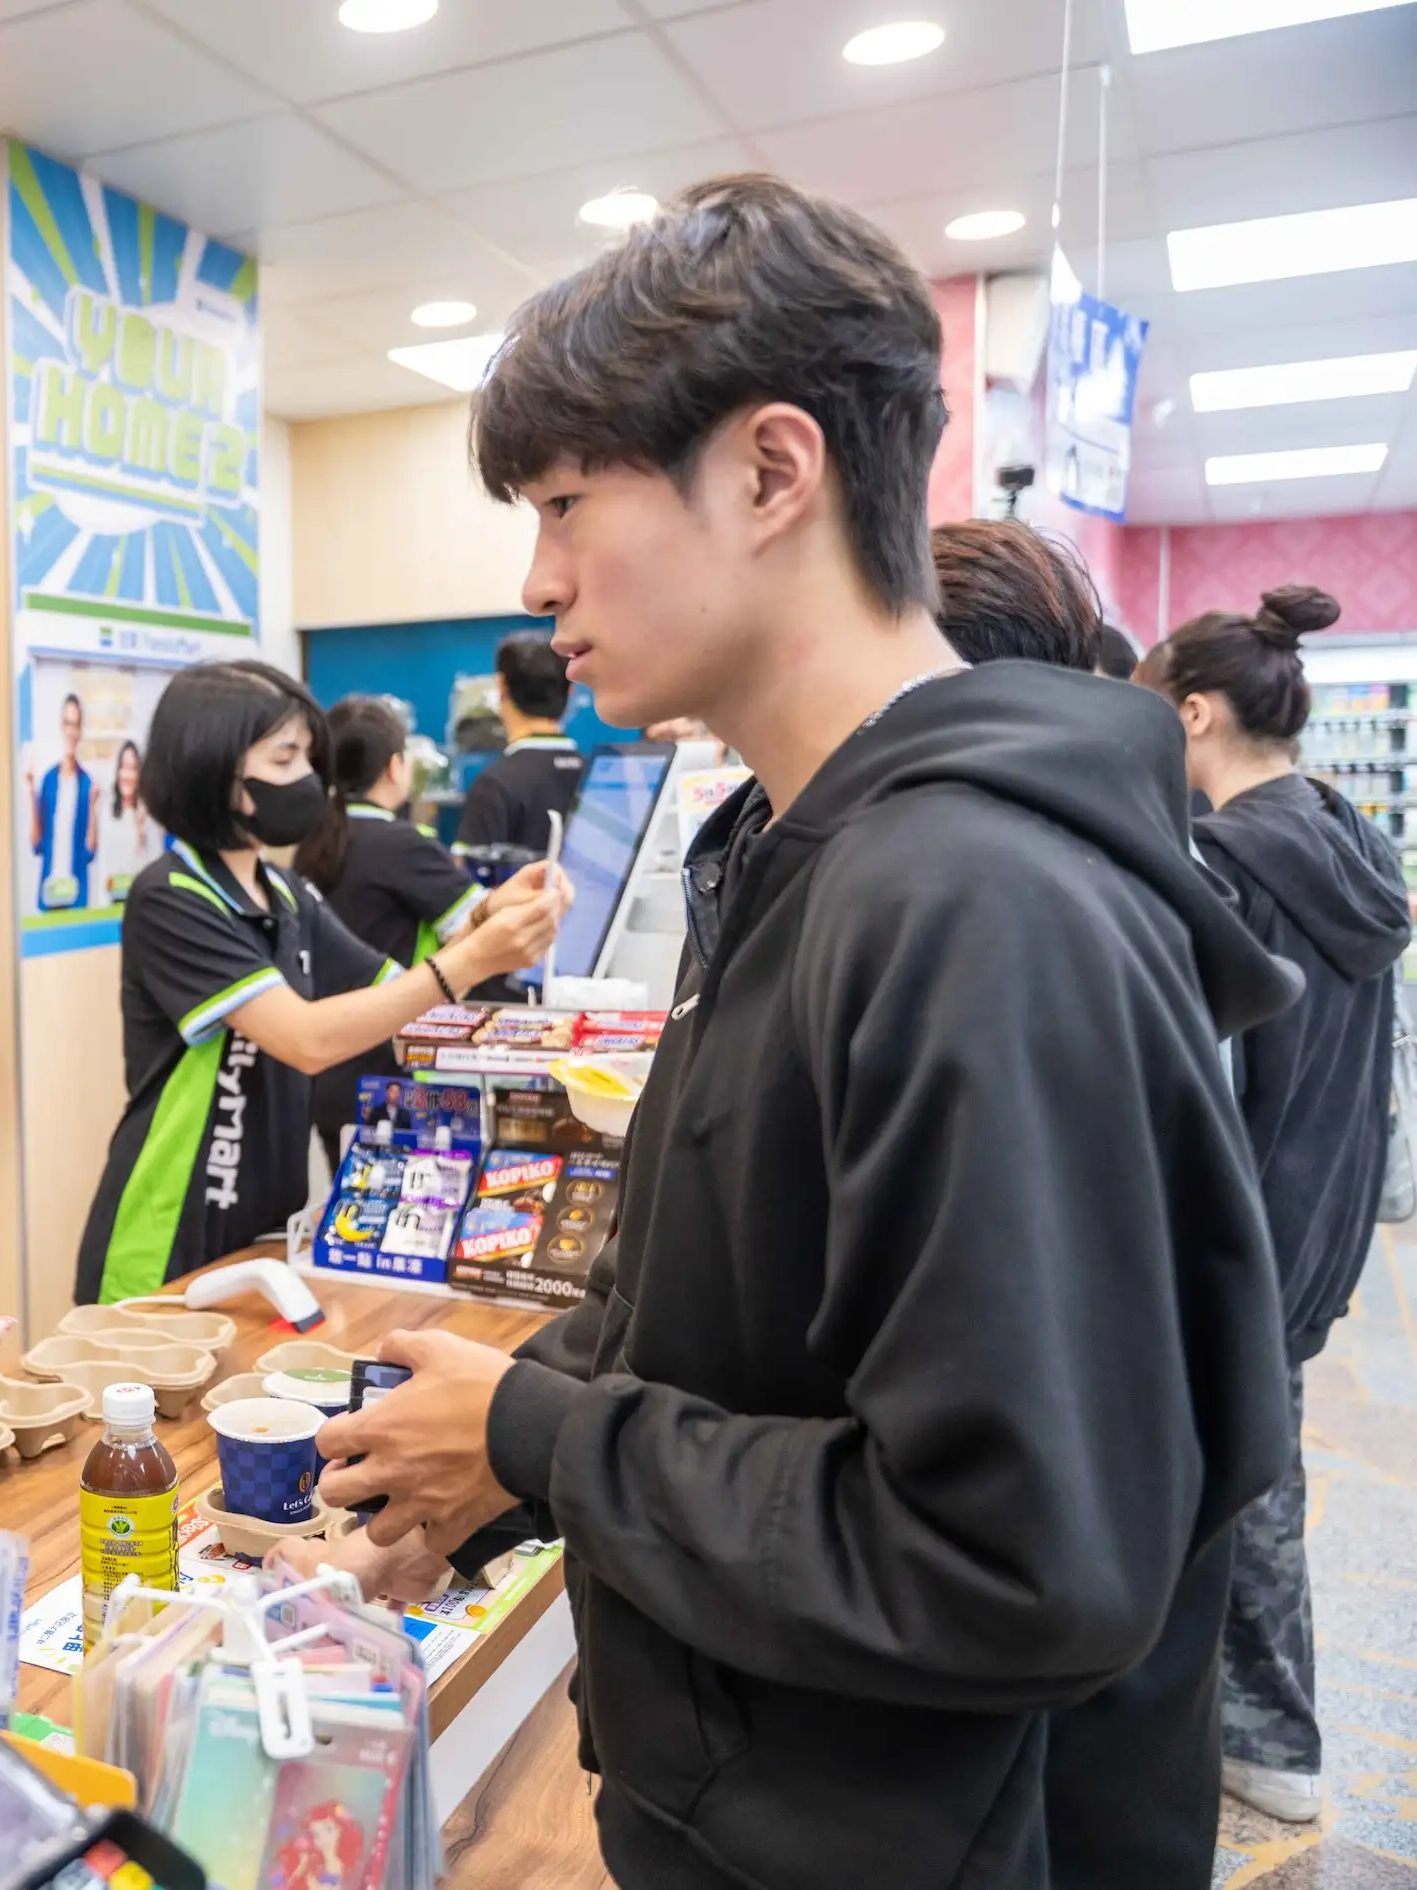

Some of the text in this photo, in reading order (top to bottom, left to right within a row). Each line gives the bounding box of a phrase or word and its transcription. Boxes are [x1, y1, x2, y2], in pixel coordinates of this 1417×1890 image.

[205, 1028, 258, 1210] ilyMart
[485, 1159, 555, 1188] KOPIKO
[462, 1226, 531, 1258] KOPIKO
